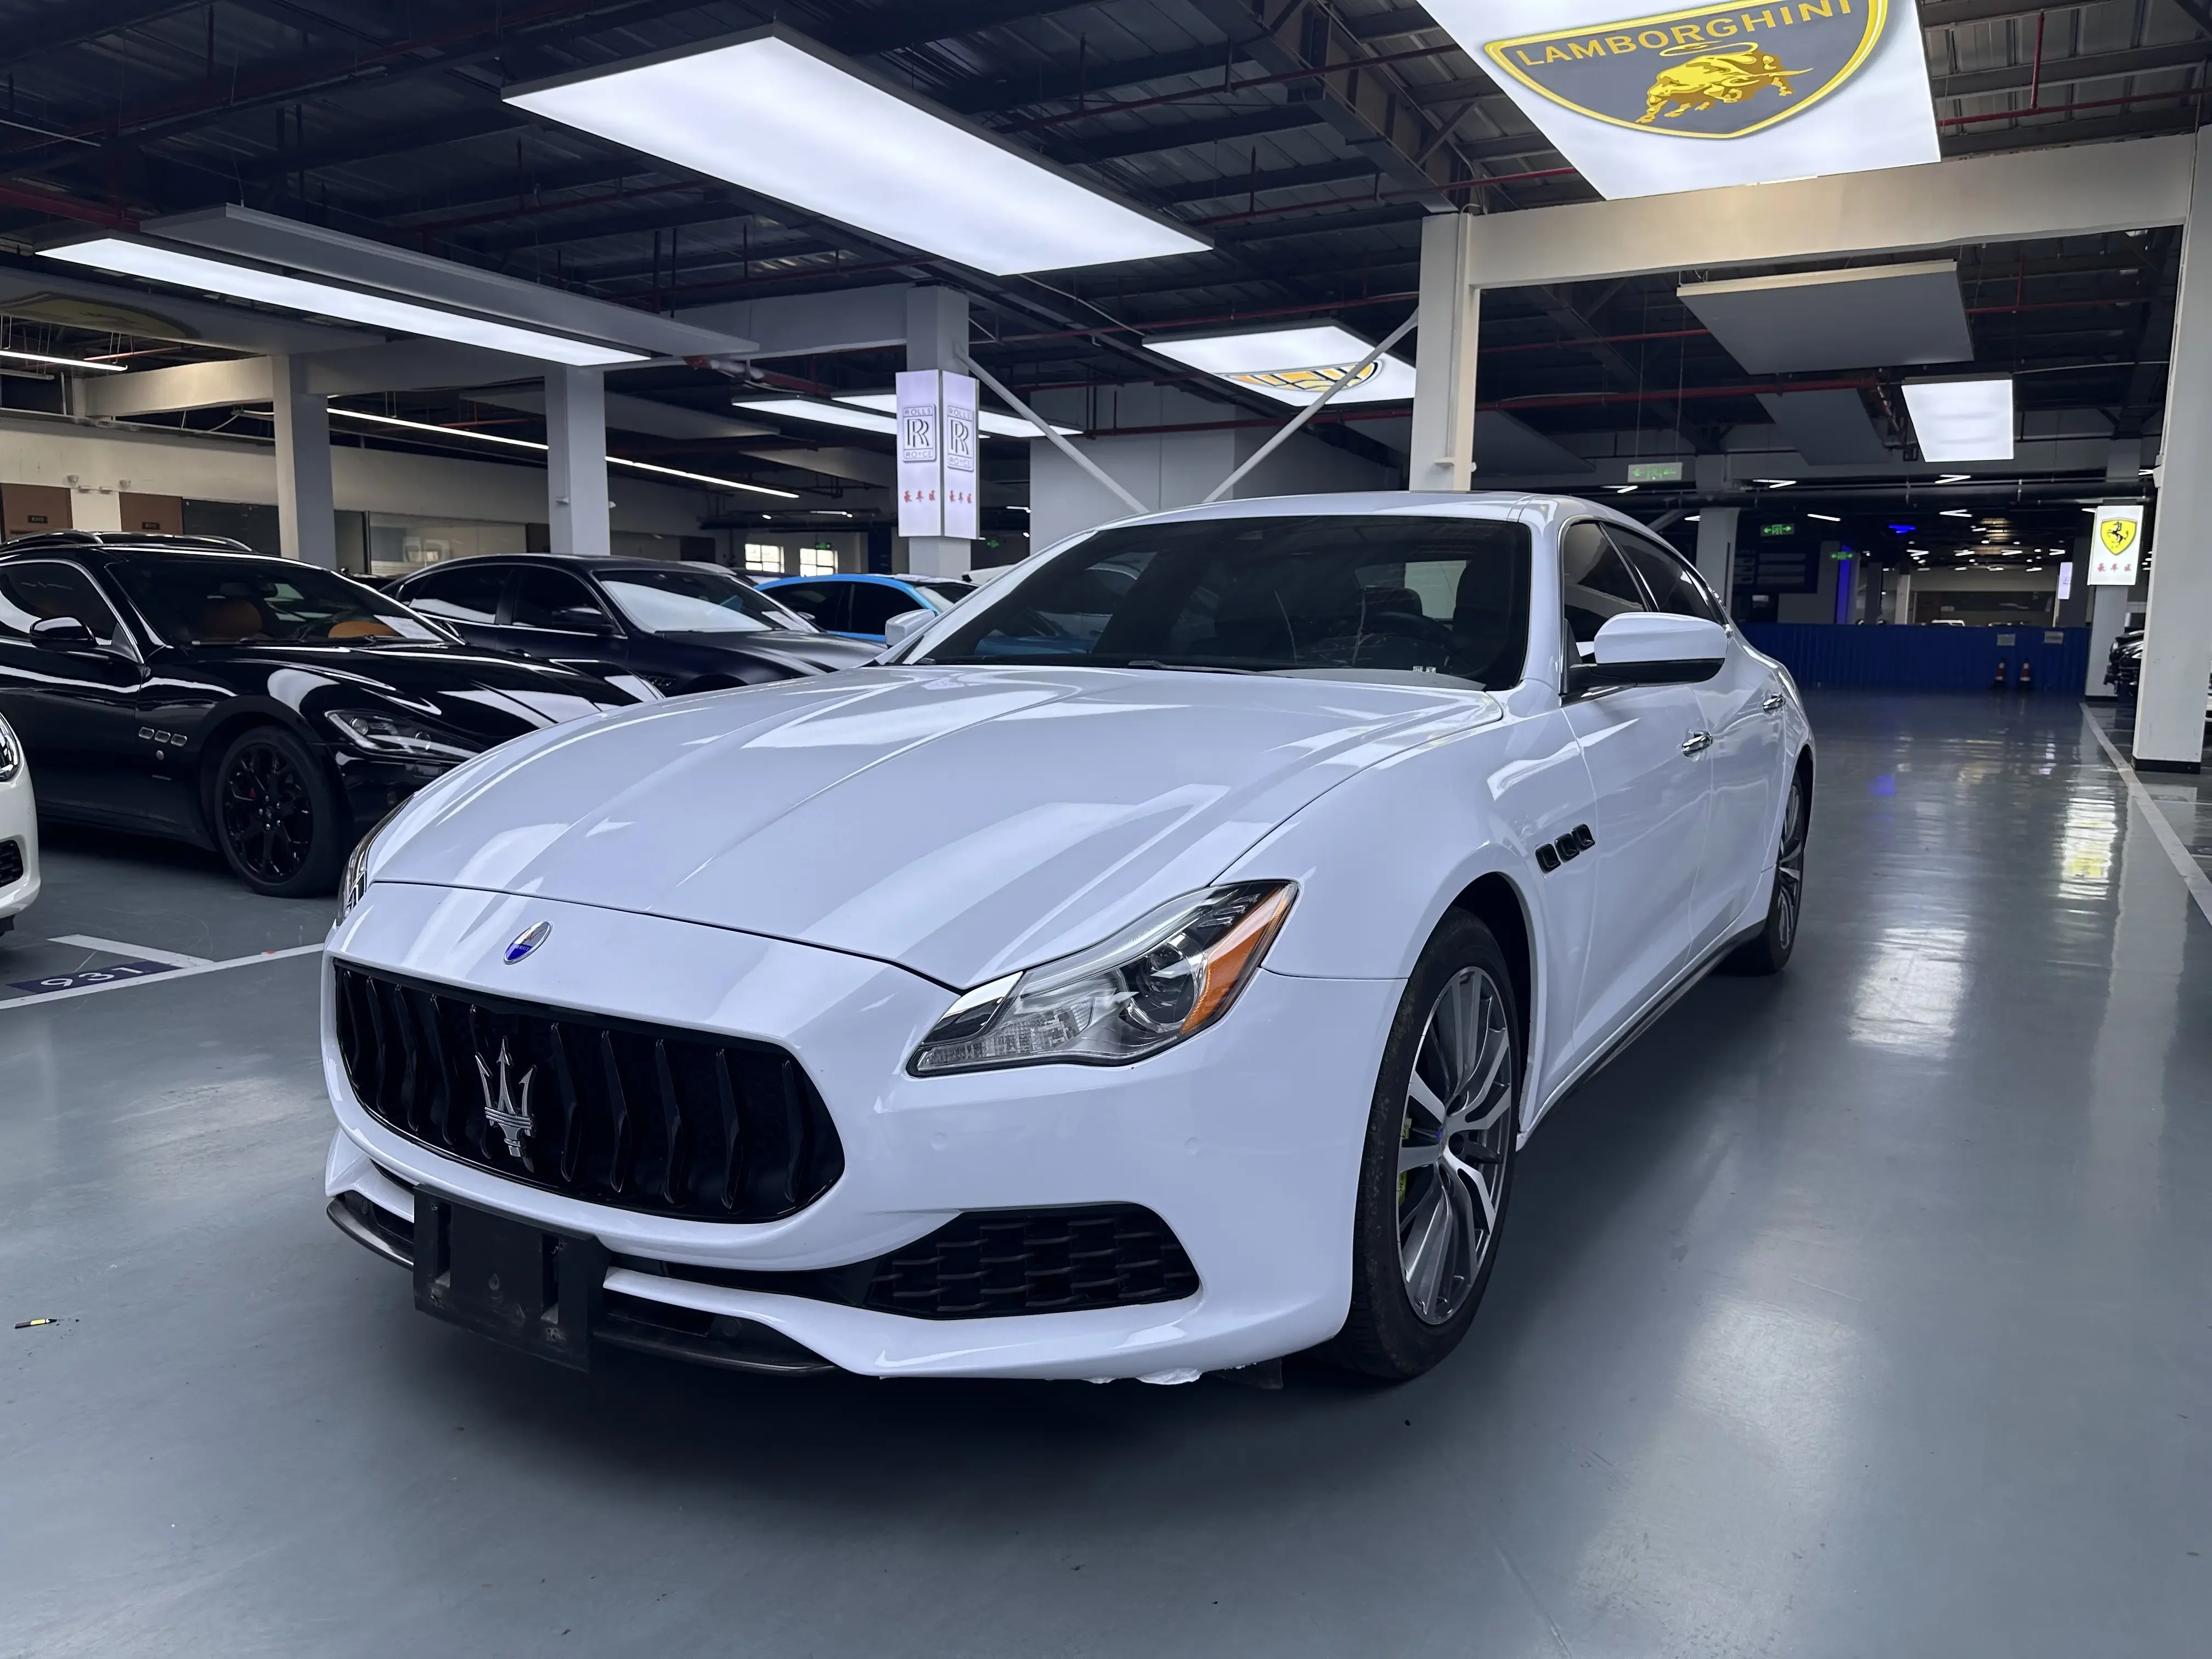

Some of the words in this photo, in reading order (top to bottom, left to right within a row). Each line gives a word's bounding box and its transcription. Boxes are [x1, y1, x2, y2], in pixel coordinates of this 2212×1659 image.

[1516, 0, 1851, 66] LAMBORGHINI
[905, 450, 933, 459] ROYCE
[41, 967, 144, 986] 931
